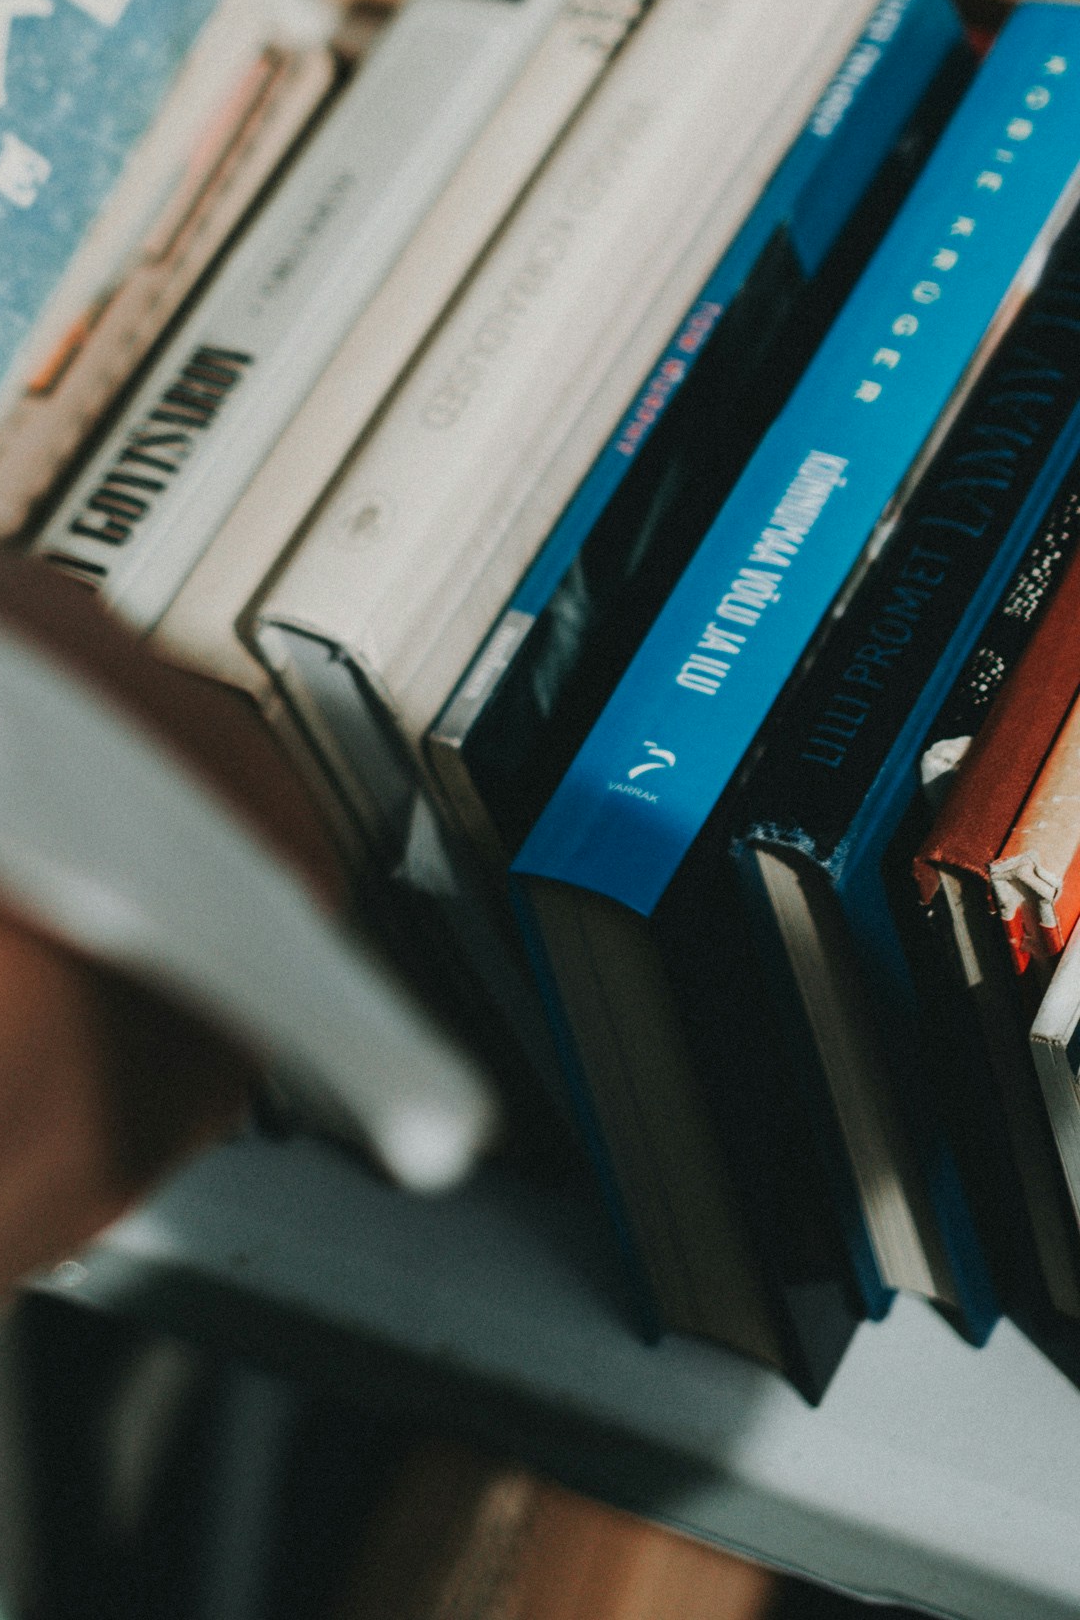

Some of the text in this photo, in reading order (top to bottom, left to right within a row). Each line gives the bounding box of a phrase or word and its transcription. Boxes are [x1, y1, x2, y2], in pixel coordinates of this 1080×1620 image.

[716, 567, 783, 627] VÕLU
[697, 621, 747, 655] JA
[801, 691, 871, 771] LILLI
[842, 545, 951, 692] PROMET
[675, 652, 732, 697] ILU
[606, 780, 660, 806] VARRAK
